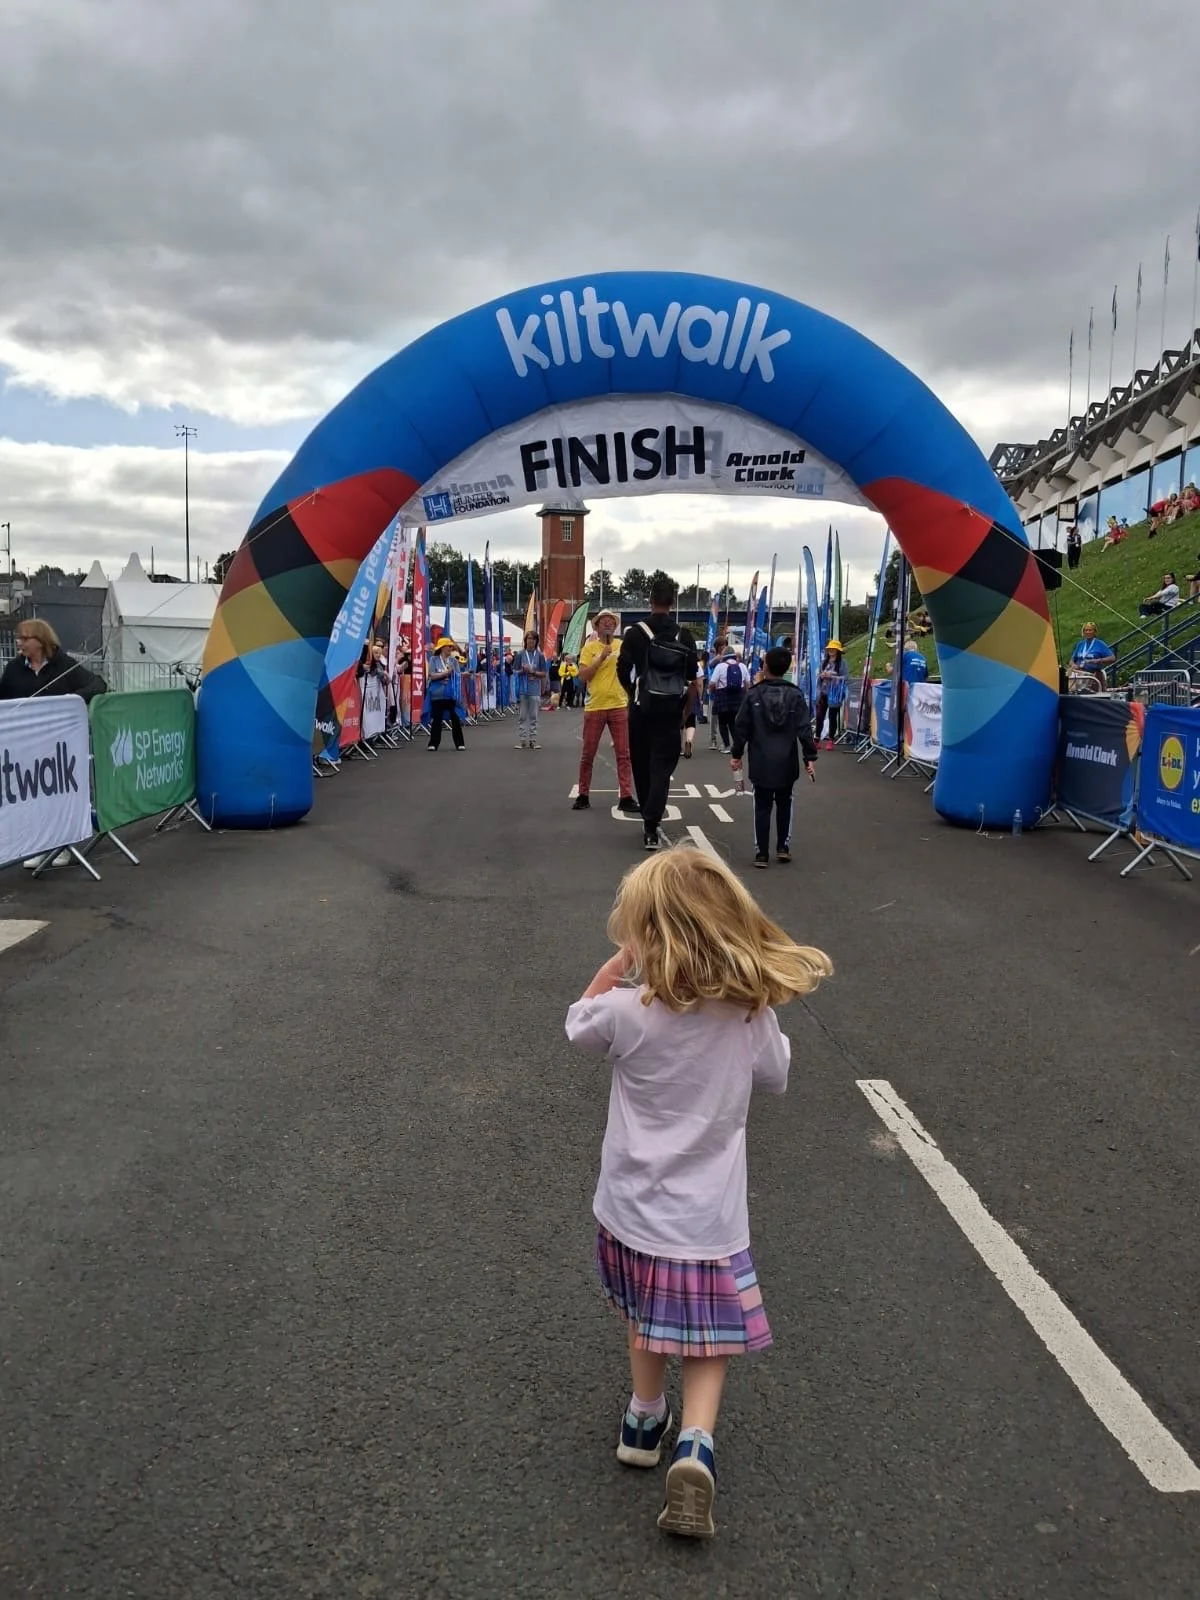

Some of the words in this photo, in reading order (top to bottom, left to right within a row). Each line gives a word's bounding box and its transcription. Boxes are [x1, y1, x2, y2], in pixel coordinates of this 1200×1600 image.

[496, 286, 791, 383] kiltwalk
[519, 425, 706, 492] FINISH
[726, 450, 805, 467] Arnold
[735, 467, 796, 482] Clark
[454, 496, 510, 514] FOUNDATION
[345, 586, 370, 639] little
[412, 587, 424, 696] kiltwalk
[314, 718, 336, 736] walk
[135, 731, 151, 761] SP
[152, 728, 186, 757] Energy
[1066, 742, 1093, 761] Arnold
[1093, 746, 1118, 767] Clark
[0, 741, 78, 806] twalk
[136, 758, 184, 791] Networks
